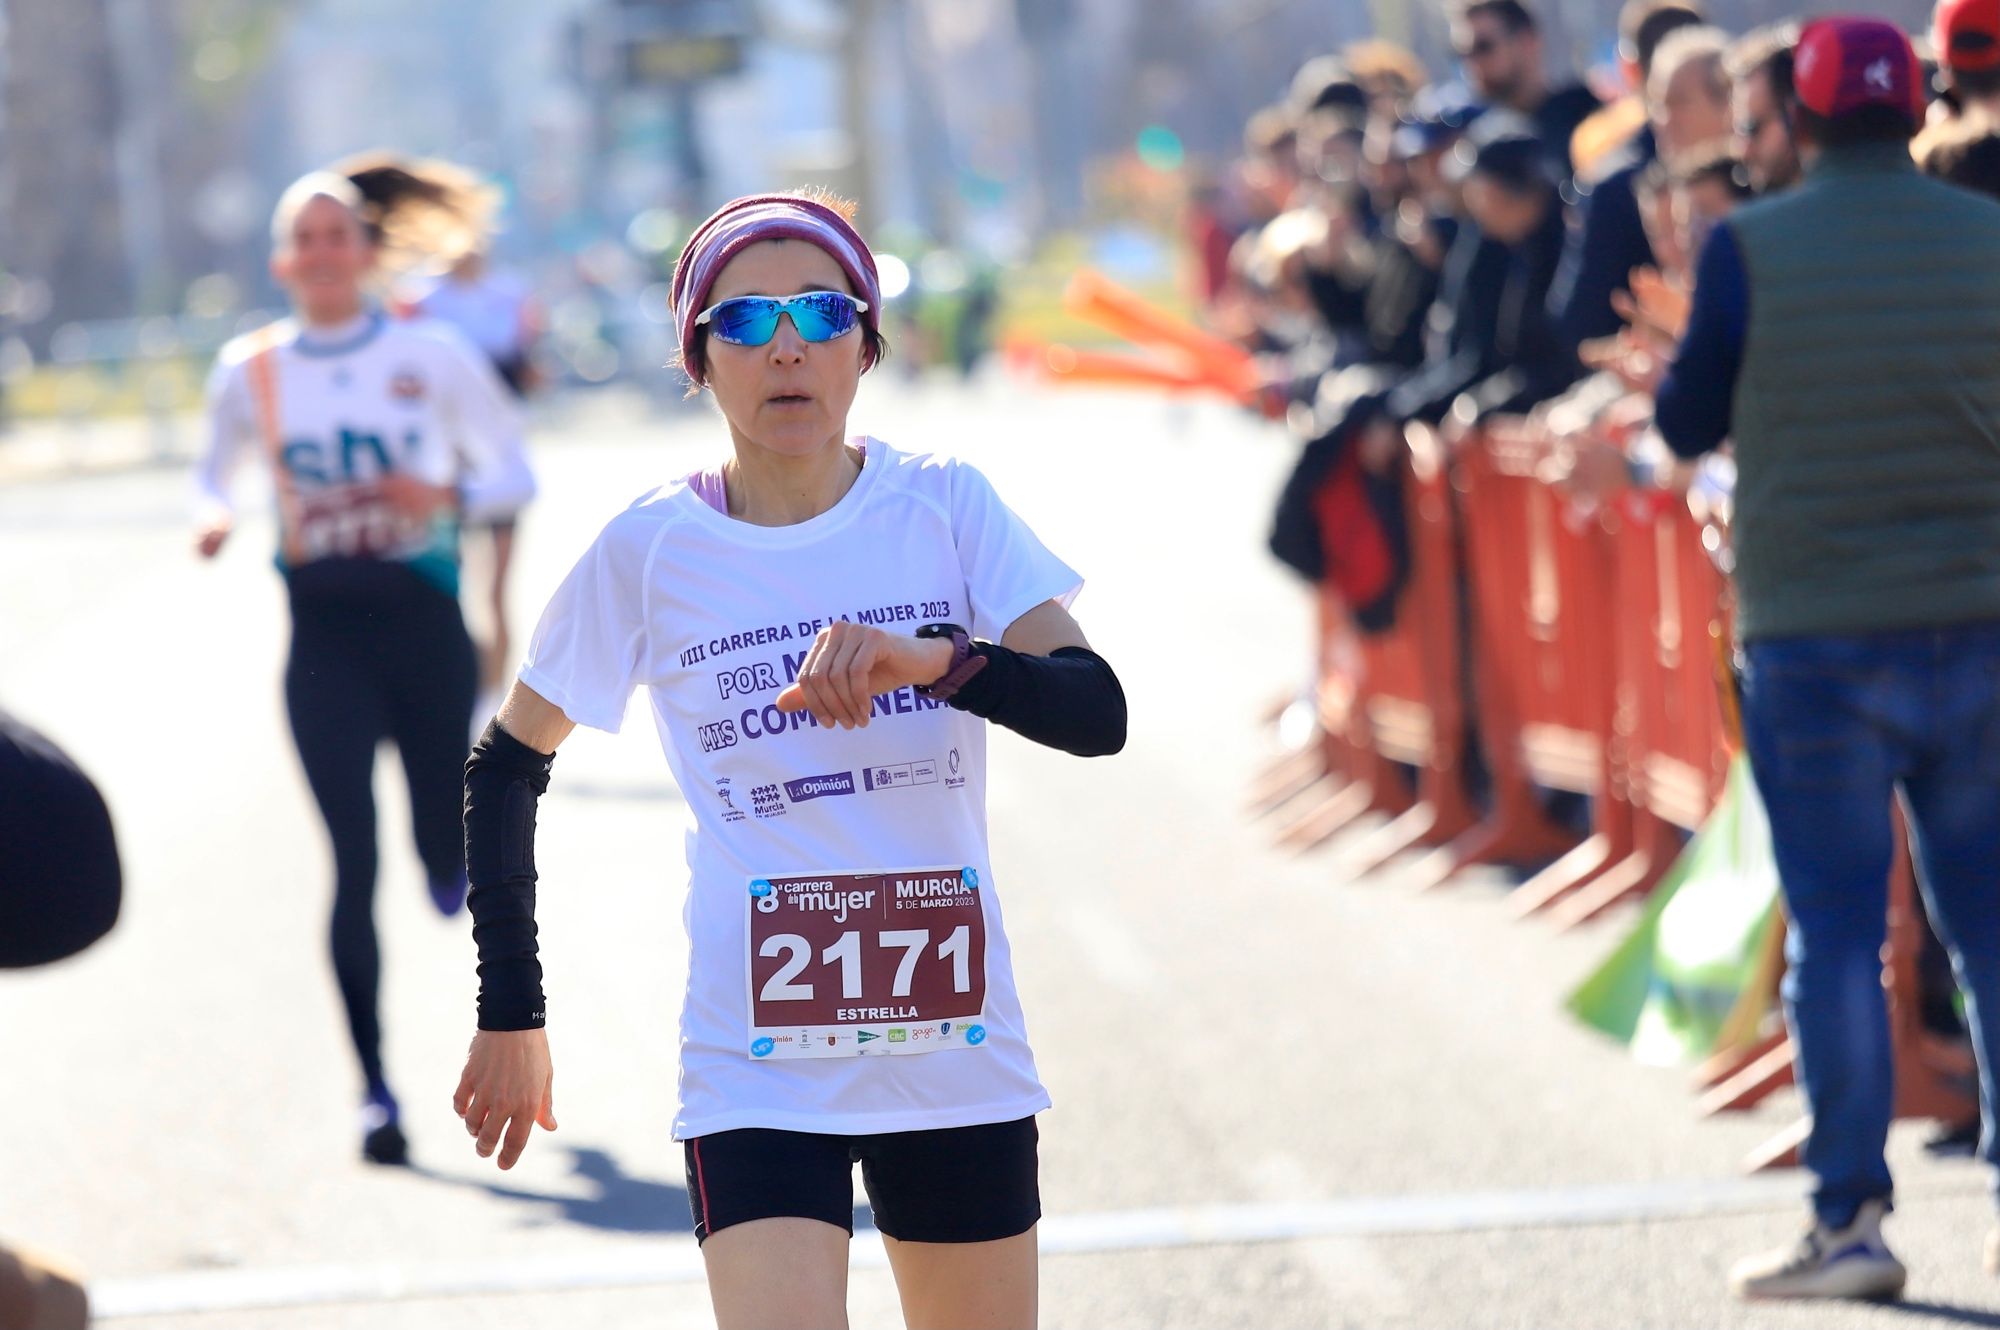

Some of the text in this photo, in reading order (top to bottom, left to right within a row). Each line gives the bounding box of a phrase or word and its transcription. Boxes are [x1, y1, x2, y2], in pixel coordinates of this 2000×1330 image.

[680, 644, 706, 668] VIII
[709, 624, 793, 656] CARRERA
[798, 619, 823, 638] DE
[857, 604, 917, 625] MUJER
[920, 601, 951, 619] 2023
[717, 662, 780, 700] POR
[698, 719, 738, 753] MIS
[754, 803, 785, 815] Murcia
[784, 881, 833, 893] carrera
[895, 877, 972, 899] MURCIA
[799, 890, 876, 923] mujer
[896, 896, 975, 910] 5 DE MARZO 2023
[758, 925, 971, 1002] 2171
[836, 1006, 919, 1021] ESTRELLA
